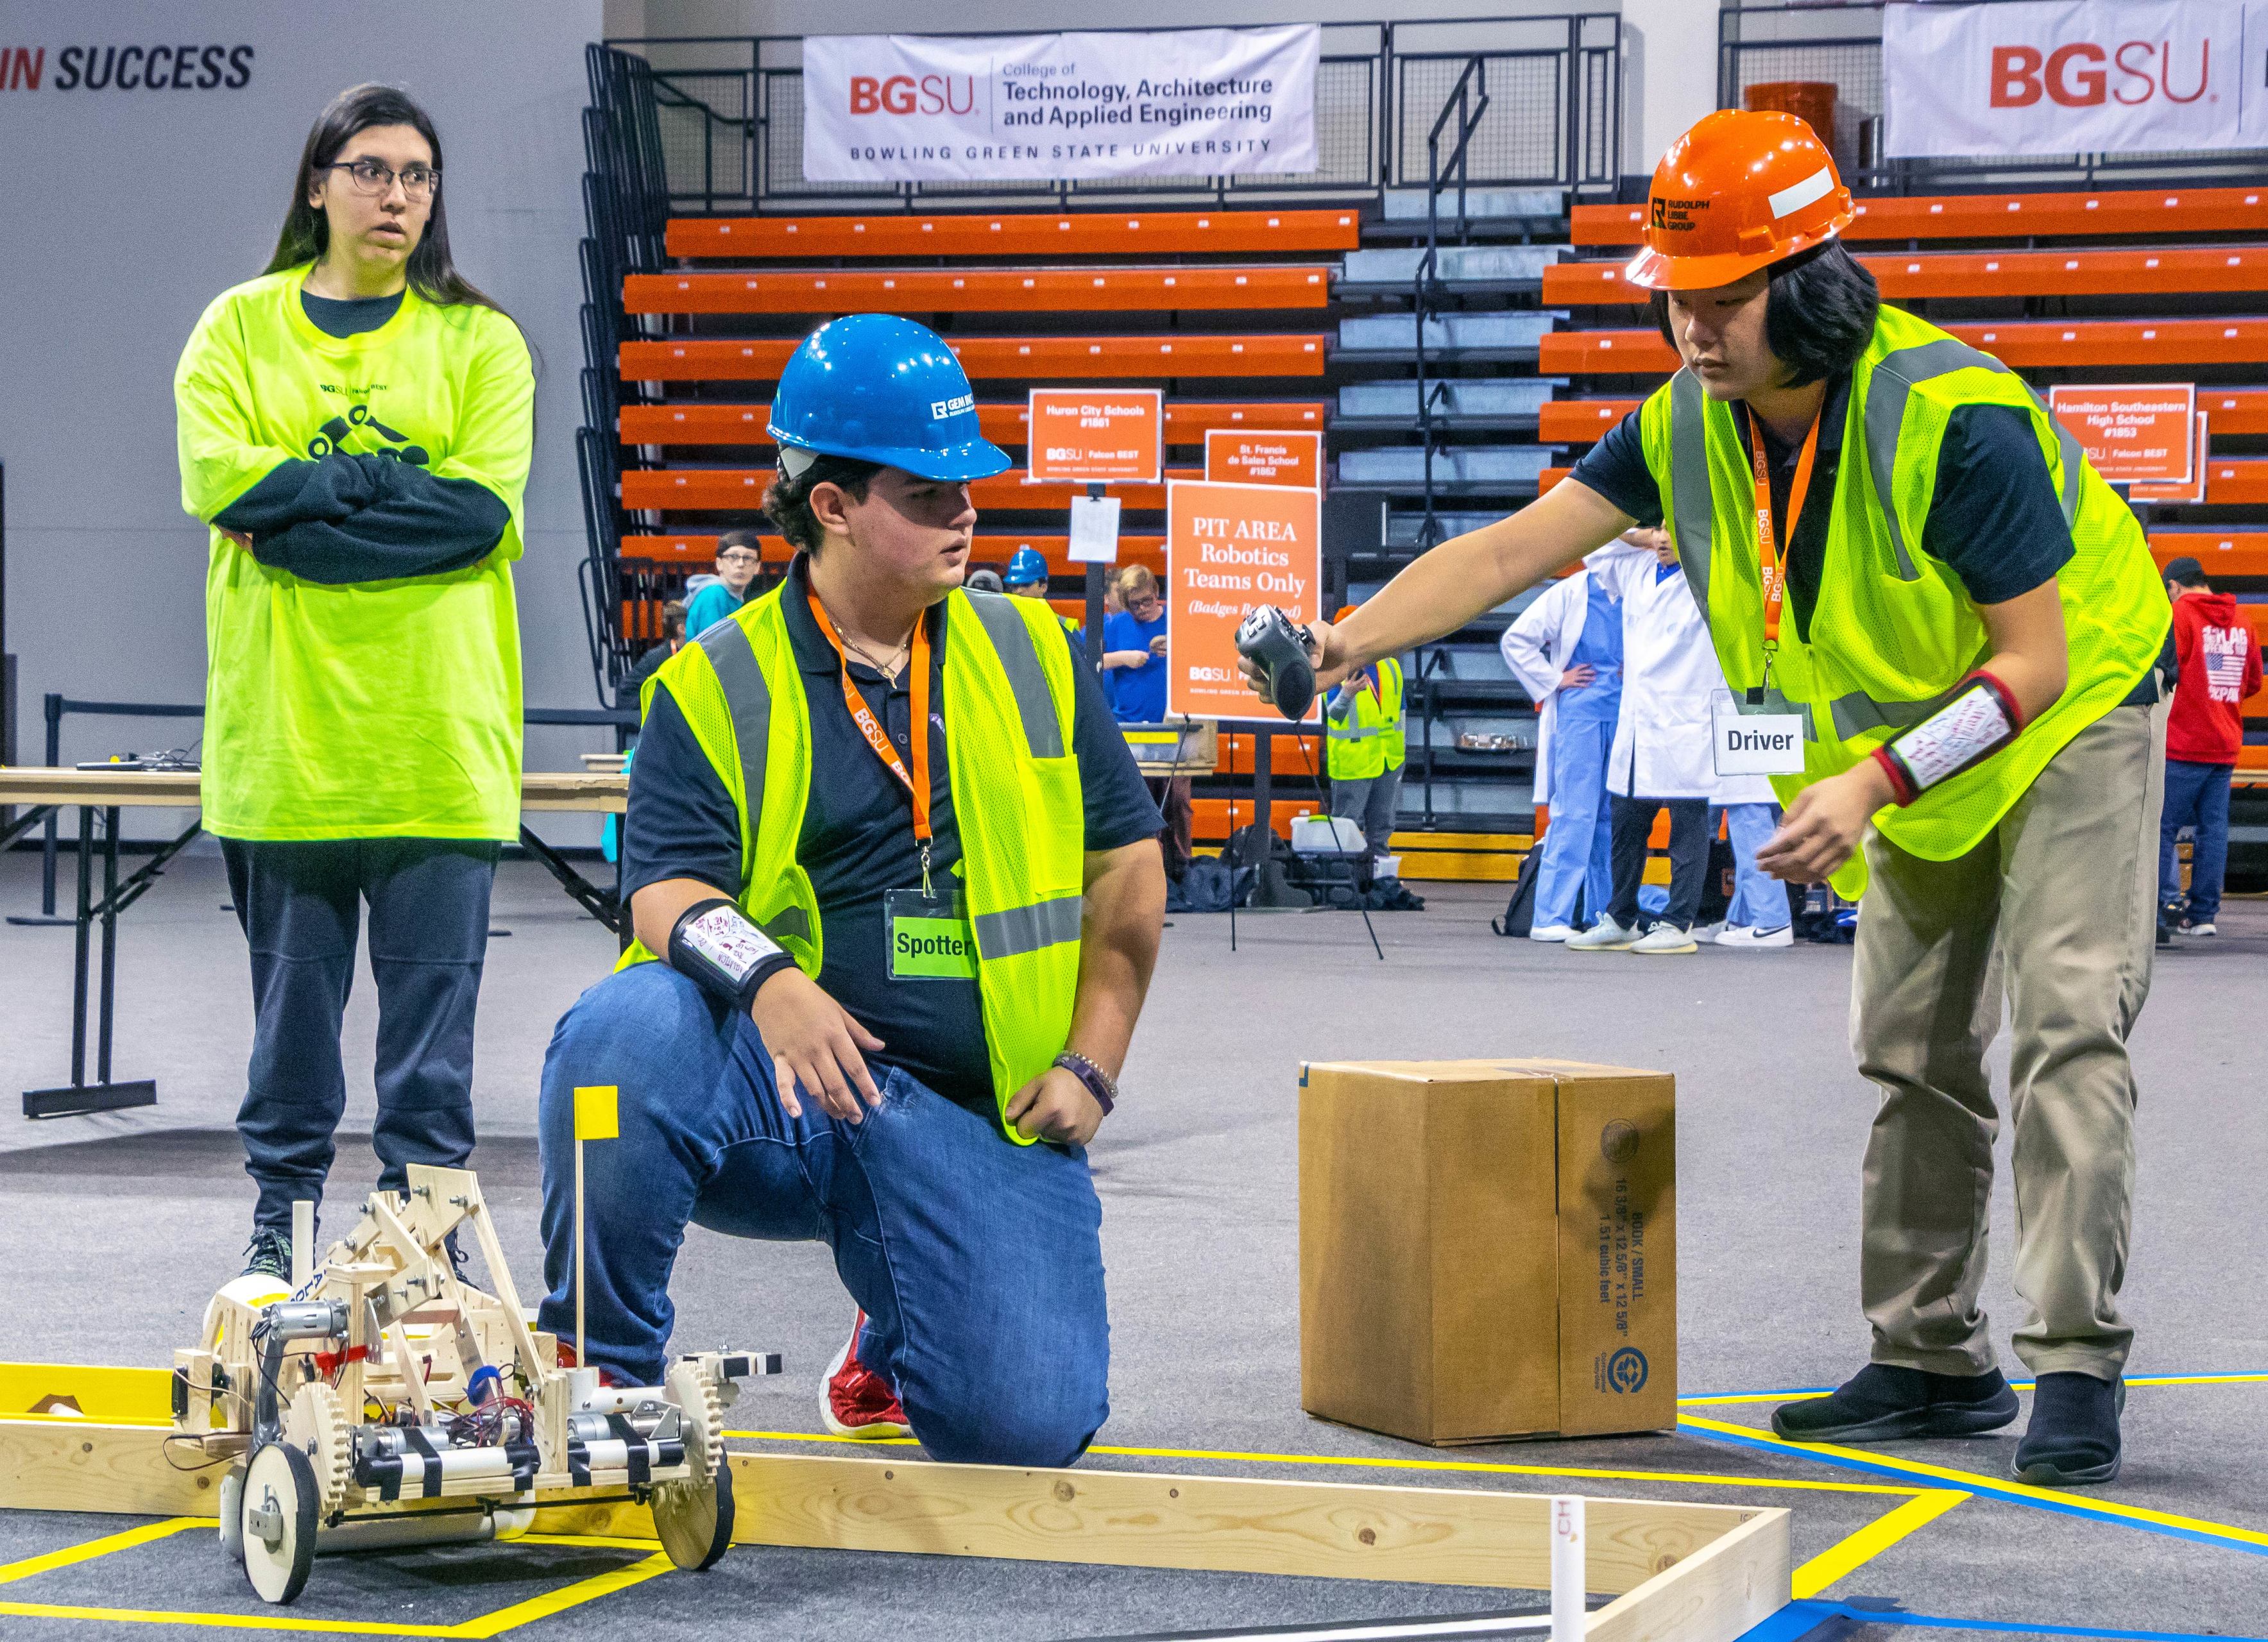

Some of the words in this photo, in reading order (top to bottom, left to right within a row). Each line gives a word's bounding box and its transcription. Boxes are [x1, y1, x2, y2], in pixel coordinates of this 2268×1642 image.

[55, 45, 255, 90] SUCCESS
[1003, 63, 1057, 78] College
[1062, 62, 1075, 74] of
[1990, 39, 2210, 108] BGSU
[849, 74, 973, 115] BGSU
[1003, 80, 1130, 103] Technology,
[1136, 78, 1273, 97] Architecture
[1004, 106, 1043, 125] and
[1049, 105, 1132, 128] Applied
[1140, 101, 1272, 126] Engineering
[851, 146, 951, 160] BOWLING
[966, 145, 1038, 160] GREEN
[1052, 143, 1118, 158] STATE
[1134, 139, 1270, 156] UNIVERSITY
[1046, 405, 1078, 416] Huron
[1080, 405, 1101, 417] City
[1104, 405, 1145, 416] Schools
[2057, 402, 2108, 412] Hamilton
[2110, 401, 2187, 412] Southeastern
[2086, 414, 2113, 427] High
[2116, 414, 2154, 425] School
[1046, 448, 1082, 461] BGSU
[1089, 450, 1115, 459] Falcon
[1117, 450, 1139, 459] BEST
[1227, 456, 1240, 464] de
[1242, 455, 1265, 465] Sales
[1268, 456, 1299, 466] School
[1255, 444, 1287, 455] Francis
[2113, 449, 2142, 457] Falcon
[2144, 448, 2169, 457] BEST
[1755, 450, 1767, 486] BGSU
[1193, 517, 1230, 537] PIT
[1234, 520, 1297, 542] AREA
[1758, 509, 1771, 544] BGSU
[1201, 543, 1290, 566] Robotics
[1184, 568, 1252, 590] Teams
[1256, 571, 1306, 599] Only
[1189, 600, 1238, 618] (Badges
[1189, 666, 1231, 682] BGSU
[854, 707, 889, 752] BGSU
[1728, 730, 1794, 750] Driver
[897, 932, 972, 958] Spotter
[1616, 1179, 1627, 1192] 16
[1600, 1214, 1611, 1241] 1.51
[1632, 1212, 1643, 1248] BOOK
[1616, 1237, 1627, 1251] 12
[1600, 1244, 1611, 1277] cubic
[1632, 1258, 1644, 1301] SMALL
[1600, 1280, 1611, 1303] feet
[1616, 1294, 1628, 1308] 12
